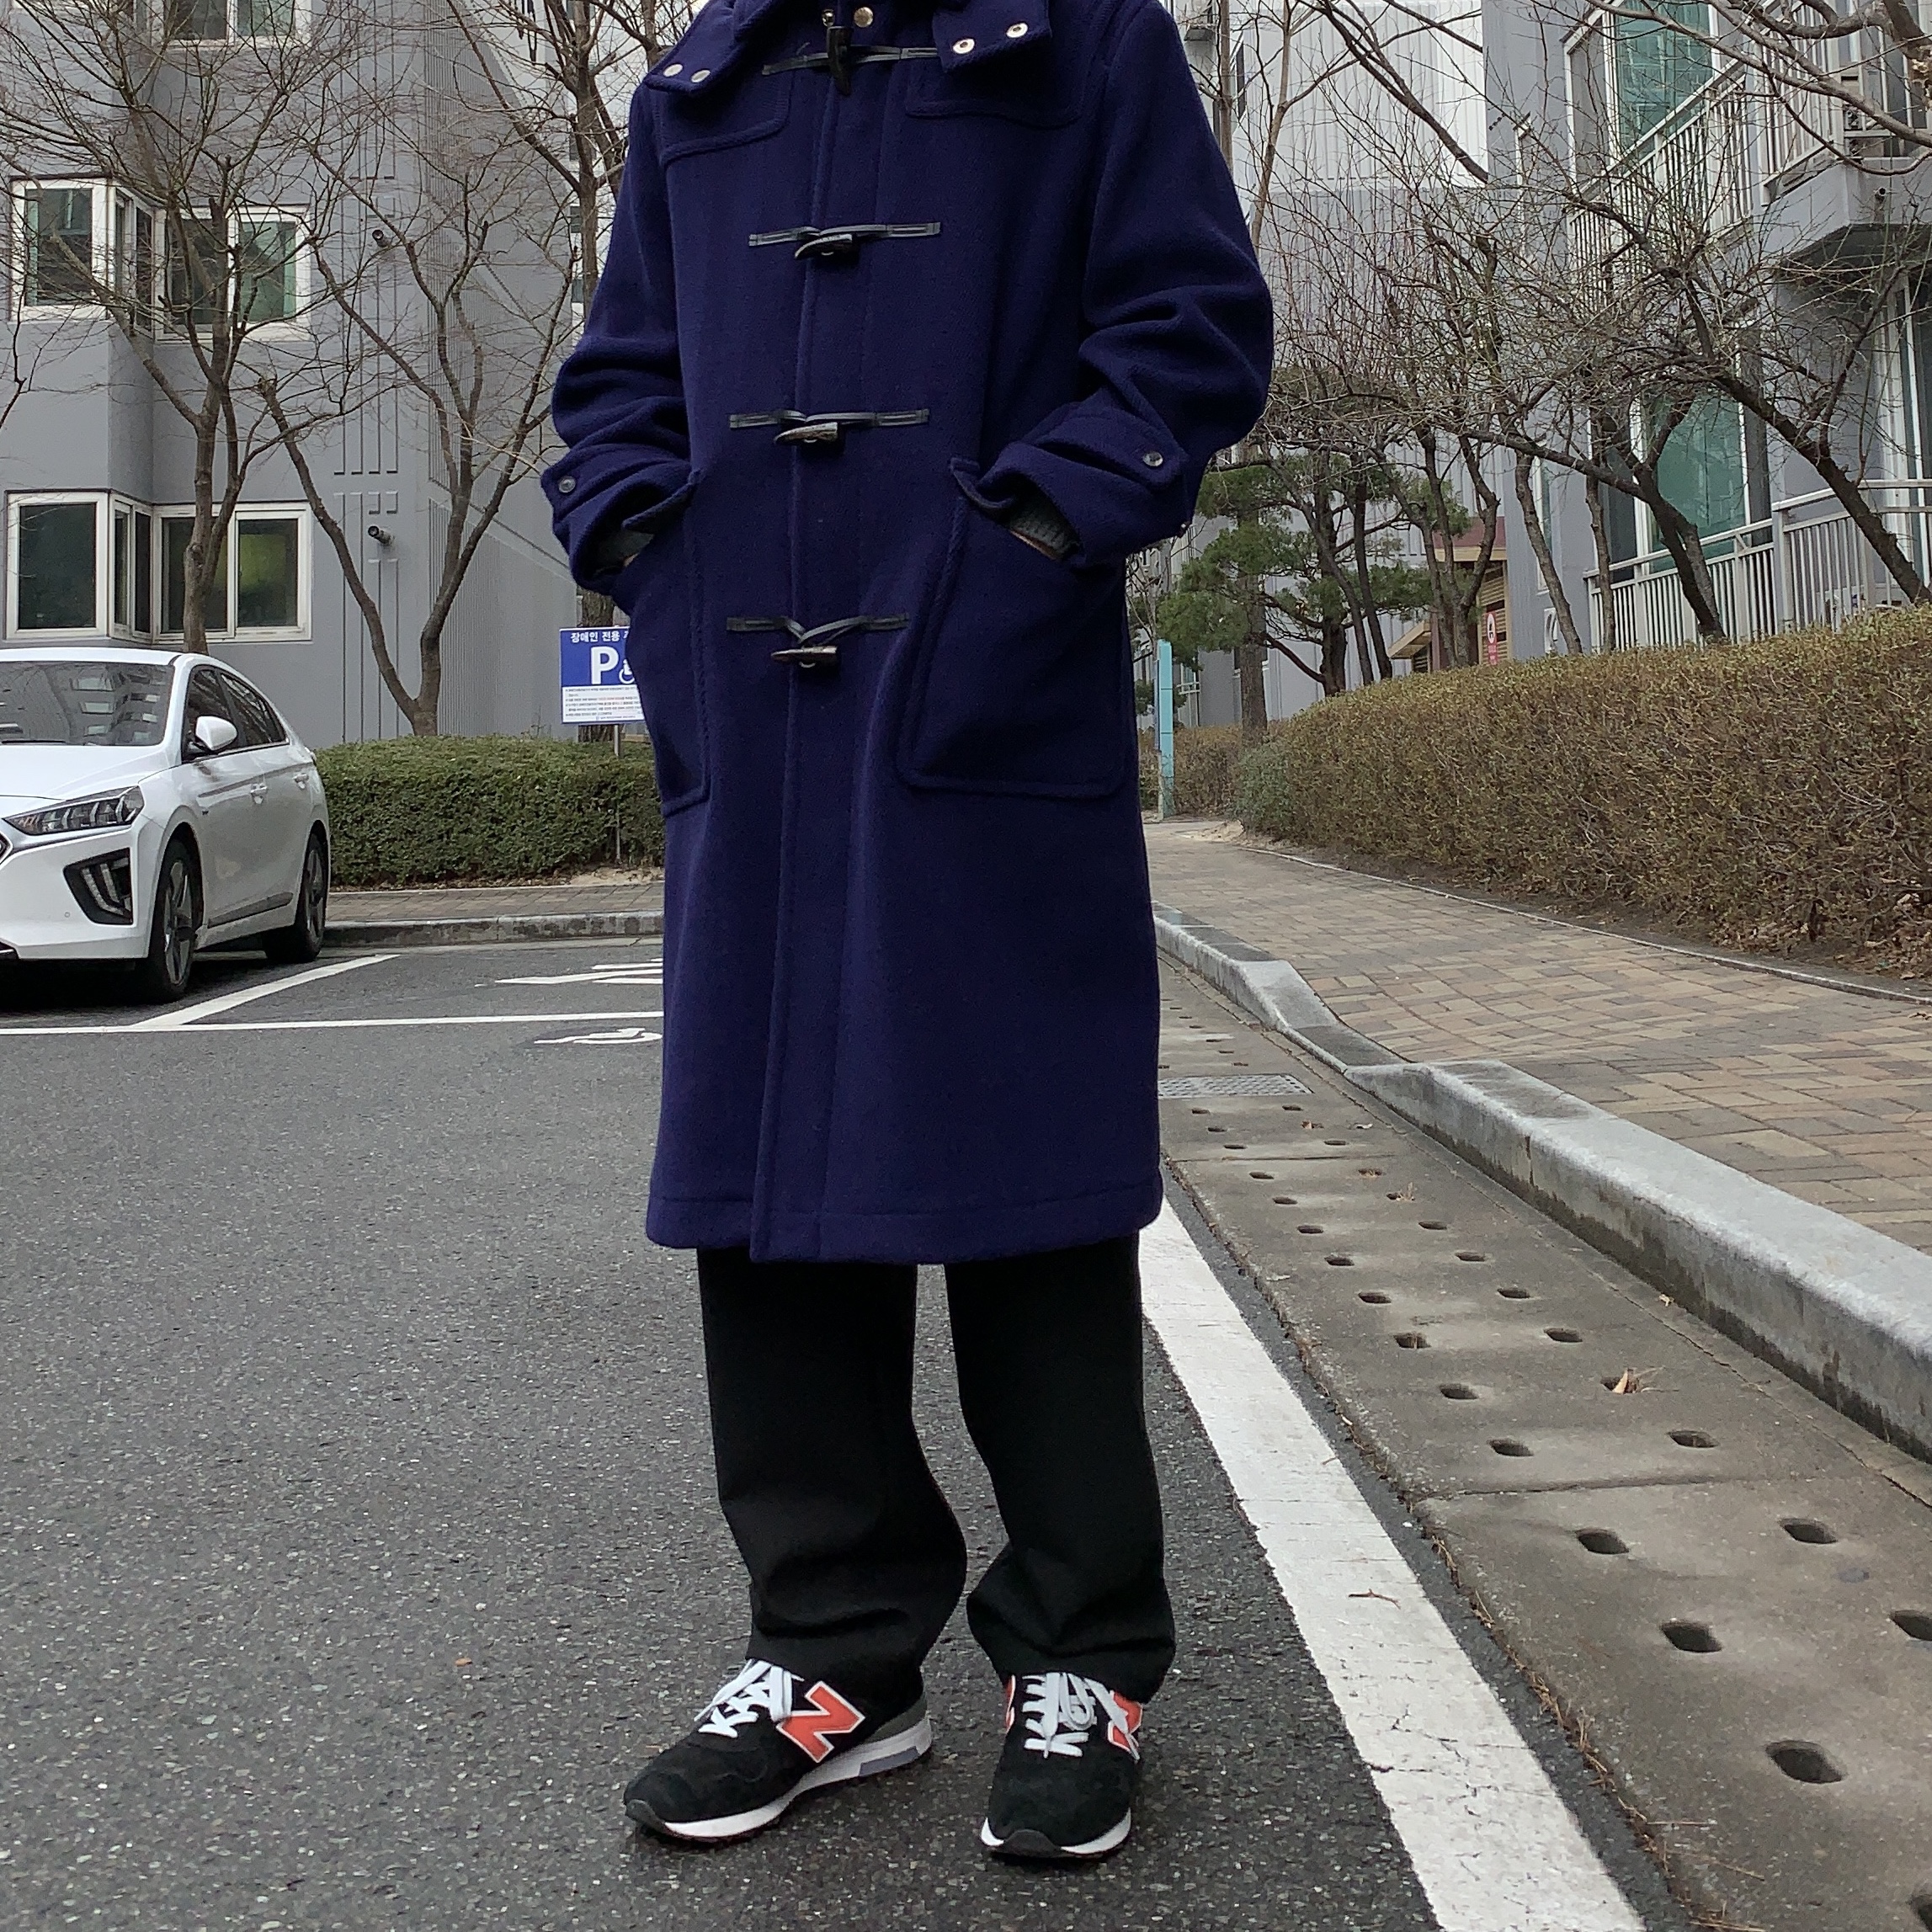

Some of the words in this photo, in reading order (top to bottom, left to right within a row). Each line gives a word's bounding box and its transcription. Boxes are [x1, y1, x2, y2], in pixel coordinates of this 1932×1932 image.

[571, 631, 598, 642] 장애인
[602, 631, 620, 641] 전용
[591, 646, 619, 684] P
[776, 1680, 865, 1763] N
